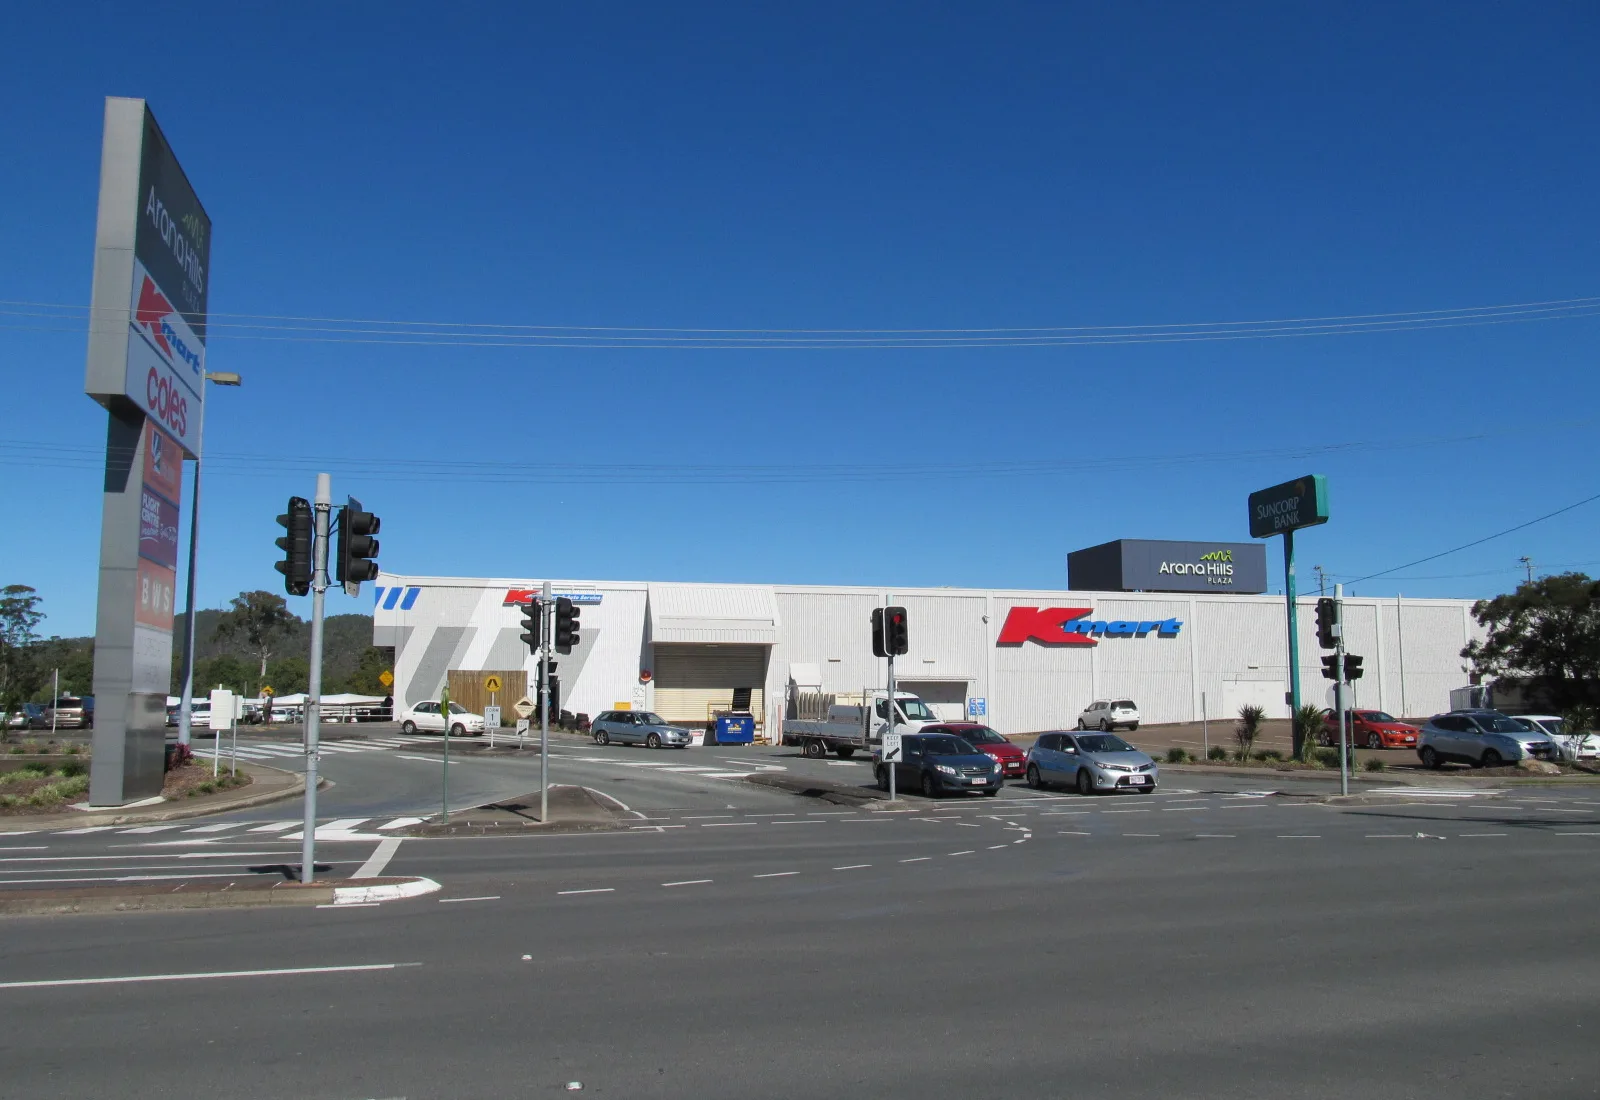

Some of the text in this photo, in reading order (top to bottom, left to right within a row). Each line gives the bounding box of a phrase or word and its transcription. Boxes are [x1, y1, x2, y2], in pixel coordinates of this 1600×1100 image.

[146, 185, 203, 294] Arana Hills
[1257, 497, 1299, 520] SUNCORP
[1274, 511, 1300, 529] BANK
[1159, 561, 1234, 576] Arana Hills
[141, 578, 171, 612] BWS
[997, 606, 1183, 644] Kmart
